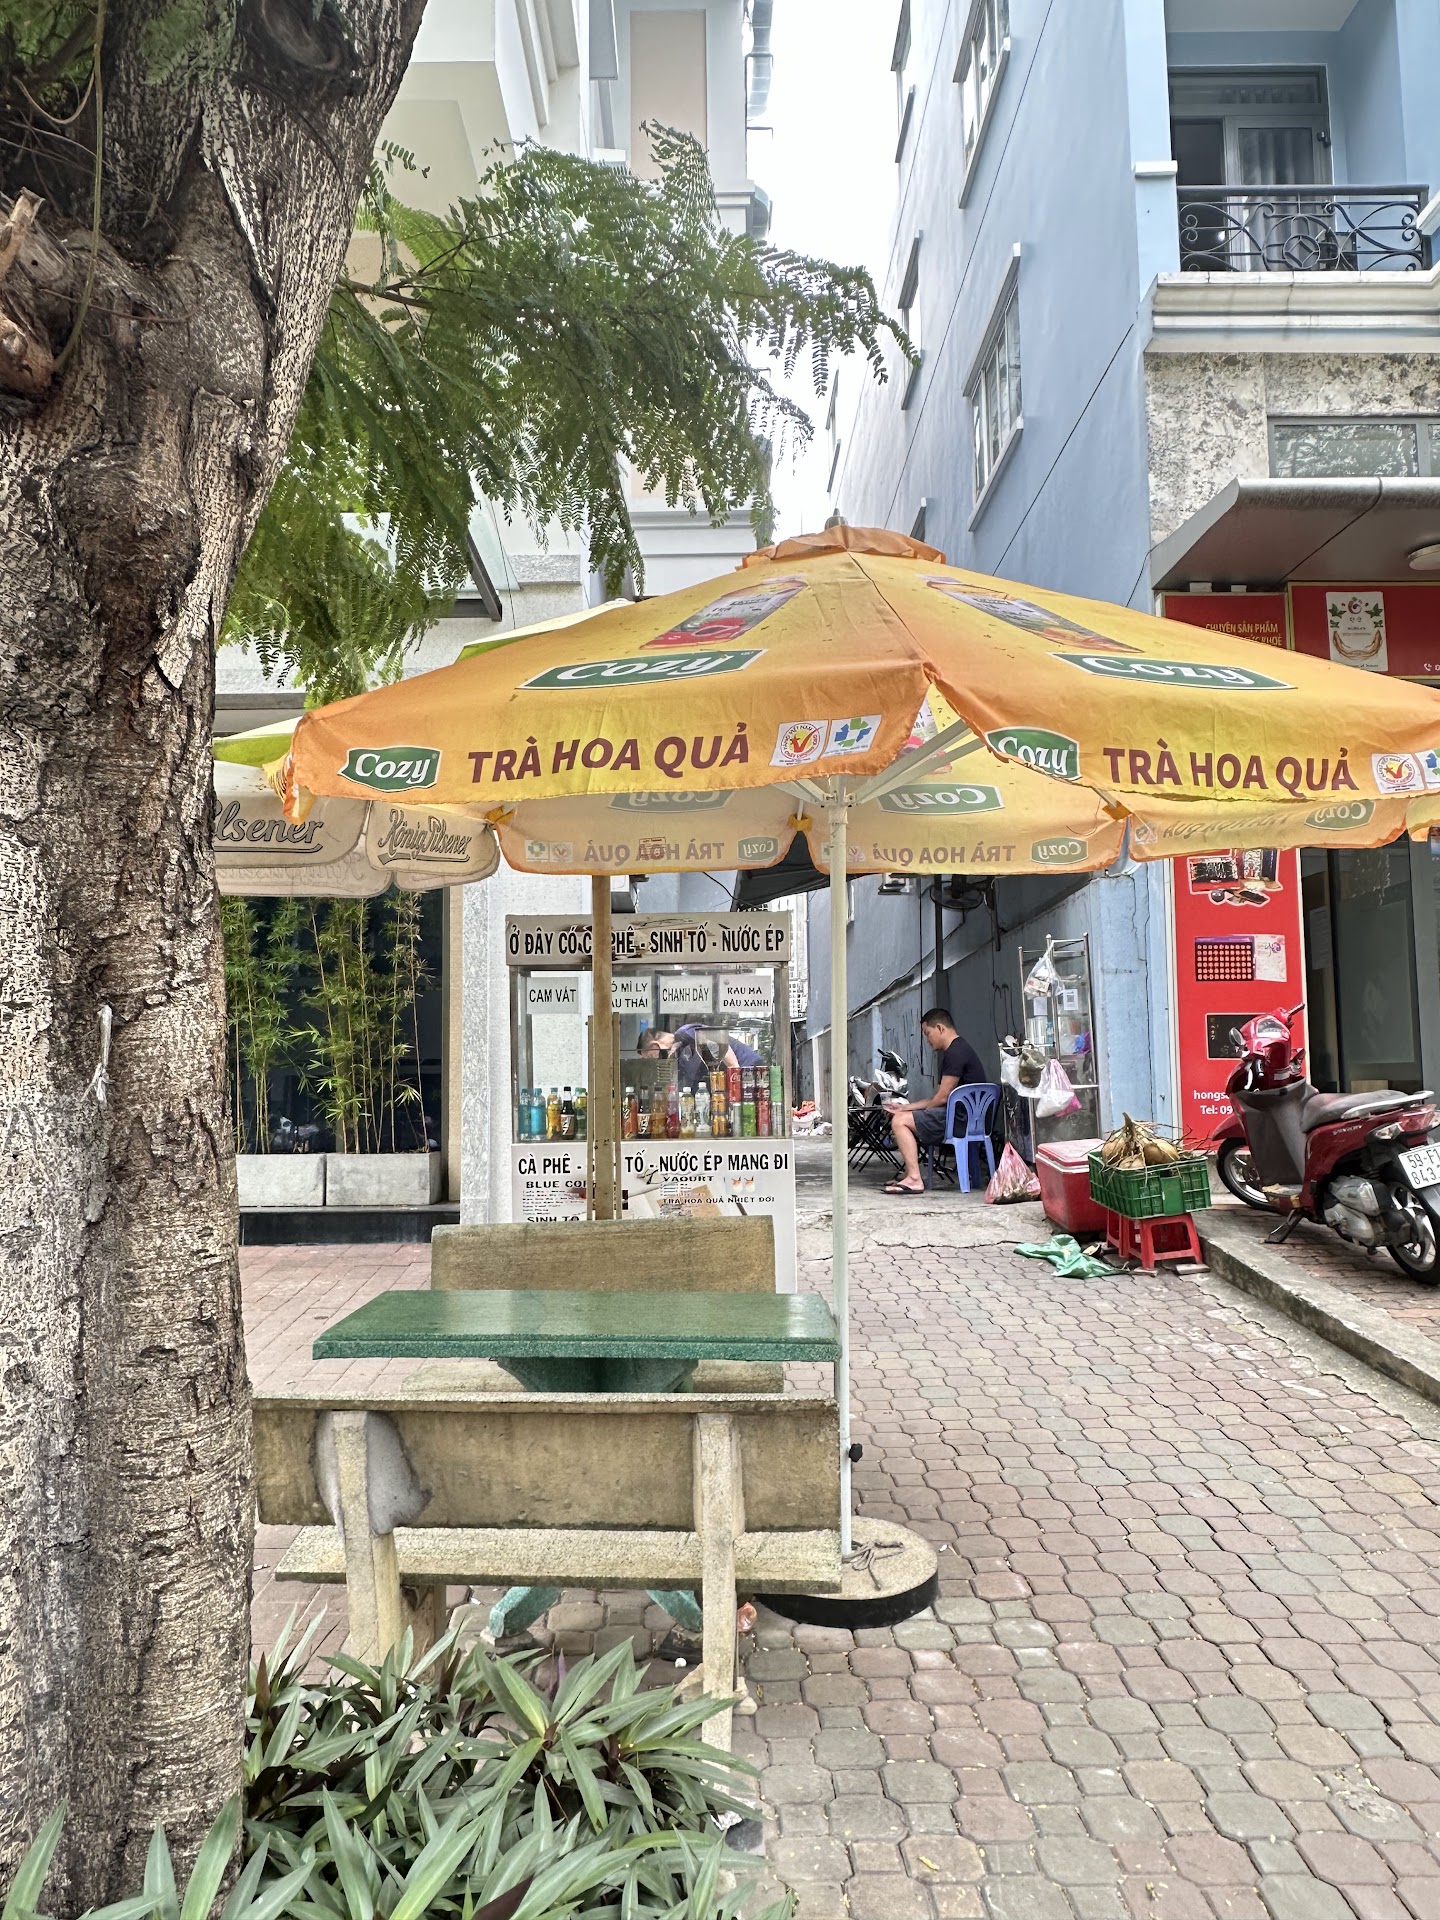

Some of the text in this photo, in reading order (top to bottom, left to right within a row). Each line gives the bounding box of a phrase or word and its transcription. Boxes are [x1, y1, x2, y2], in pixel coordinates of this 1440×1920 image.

[557, 656, 734, 680] Cozy
[1082, 657, 1254, 685] Cozy
[468, 735, 542, 784] TRÀ
[552, 738, 640, 774] HOA
[654, 722, 749, 778] QUẢ
[998, 736, 1068, 776] Cozy
[355, 753, 432, 784] Cozy
[1103, 738, 1182, 786] TRÀ
[1189, 751, 1268, 790] HOA
[1276, 747, 1360, 798] QUẢ
[215, 800, 324, 844] lsener
[525, 926, 554, 954] ĐÂY
[650, 932, 683, 953] SINH
[688, 922, 708, 952] TỐ
[766, 924, 784, 952] ÉP
[530, 988, 552, 1003] CAM
[662, 988, 690, 1002] CHANH
[1200, 1105, 1218, 1114] Tel:
[518, 1153, 536, 1174] CÀ
[543, 1153, 570, 1174] PHÊ
[625, 1150, 646, 1172] TỐ
[659, 1151, 698, 1172] NƯỚC
[704, 1150, 723, 1172] ÉP
[728, 1154, 769, 1171] MANG
[774, 1154, 788, 1170] ĐI
[526, 1180, 560, 1188] BLUE
